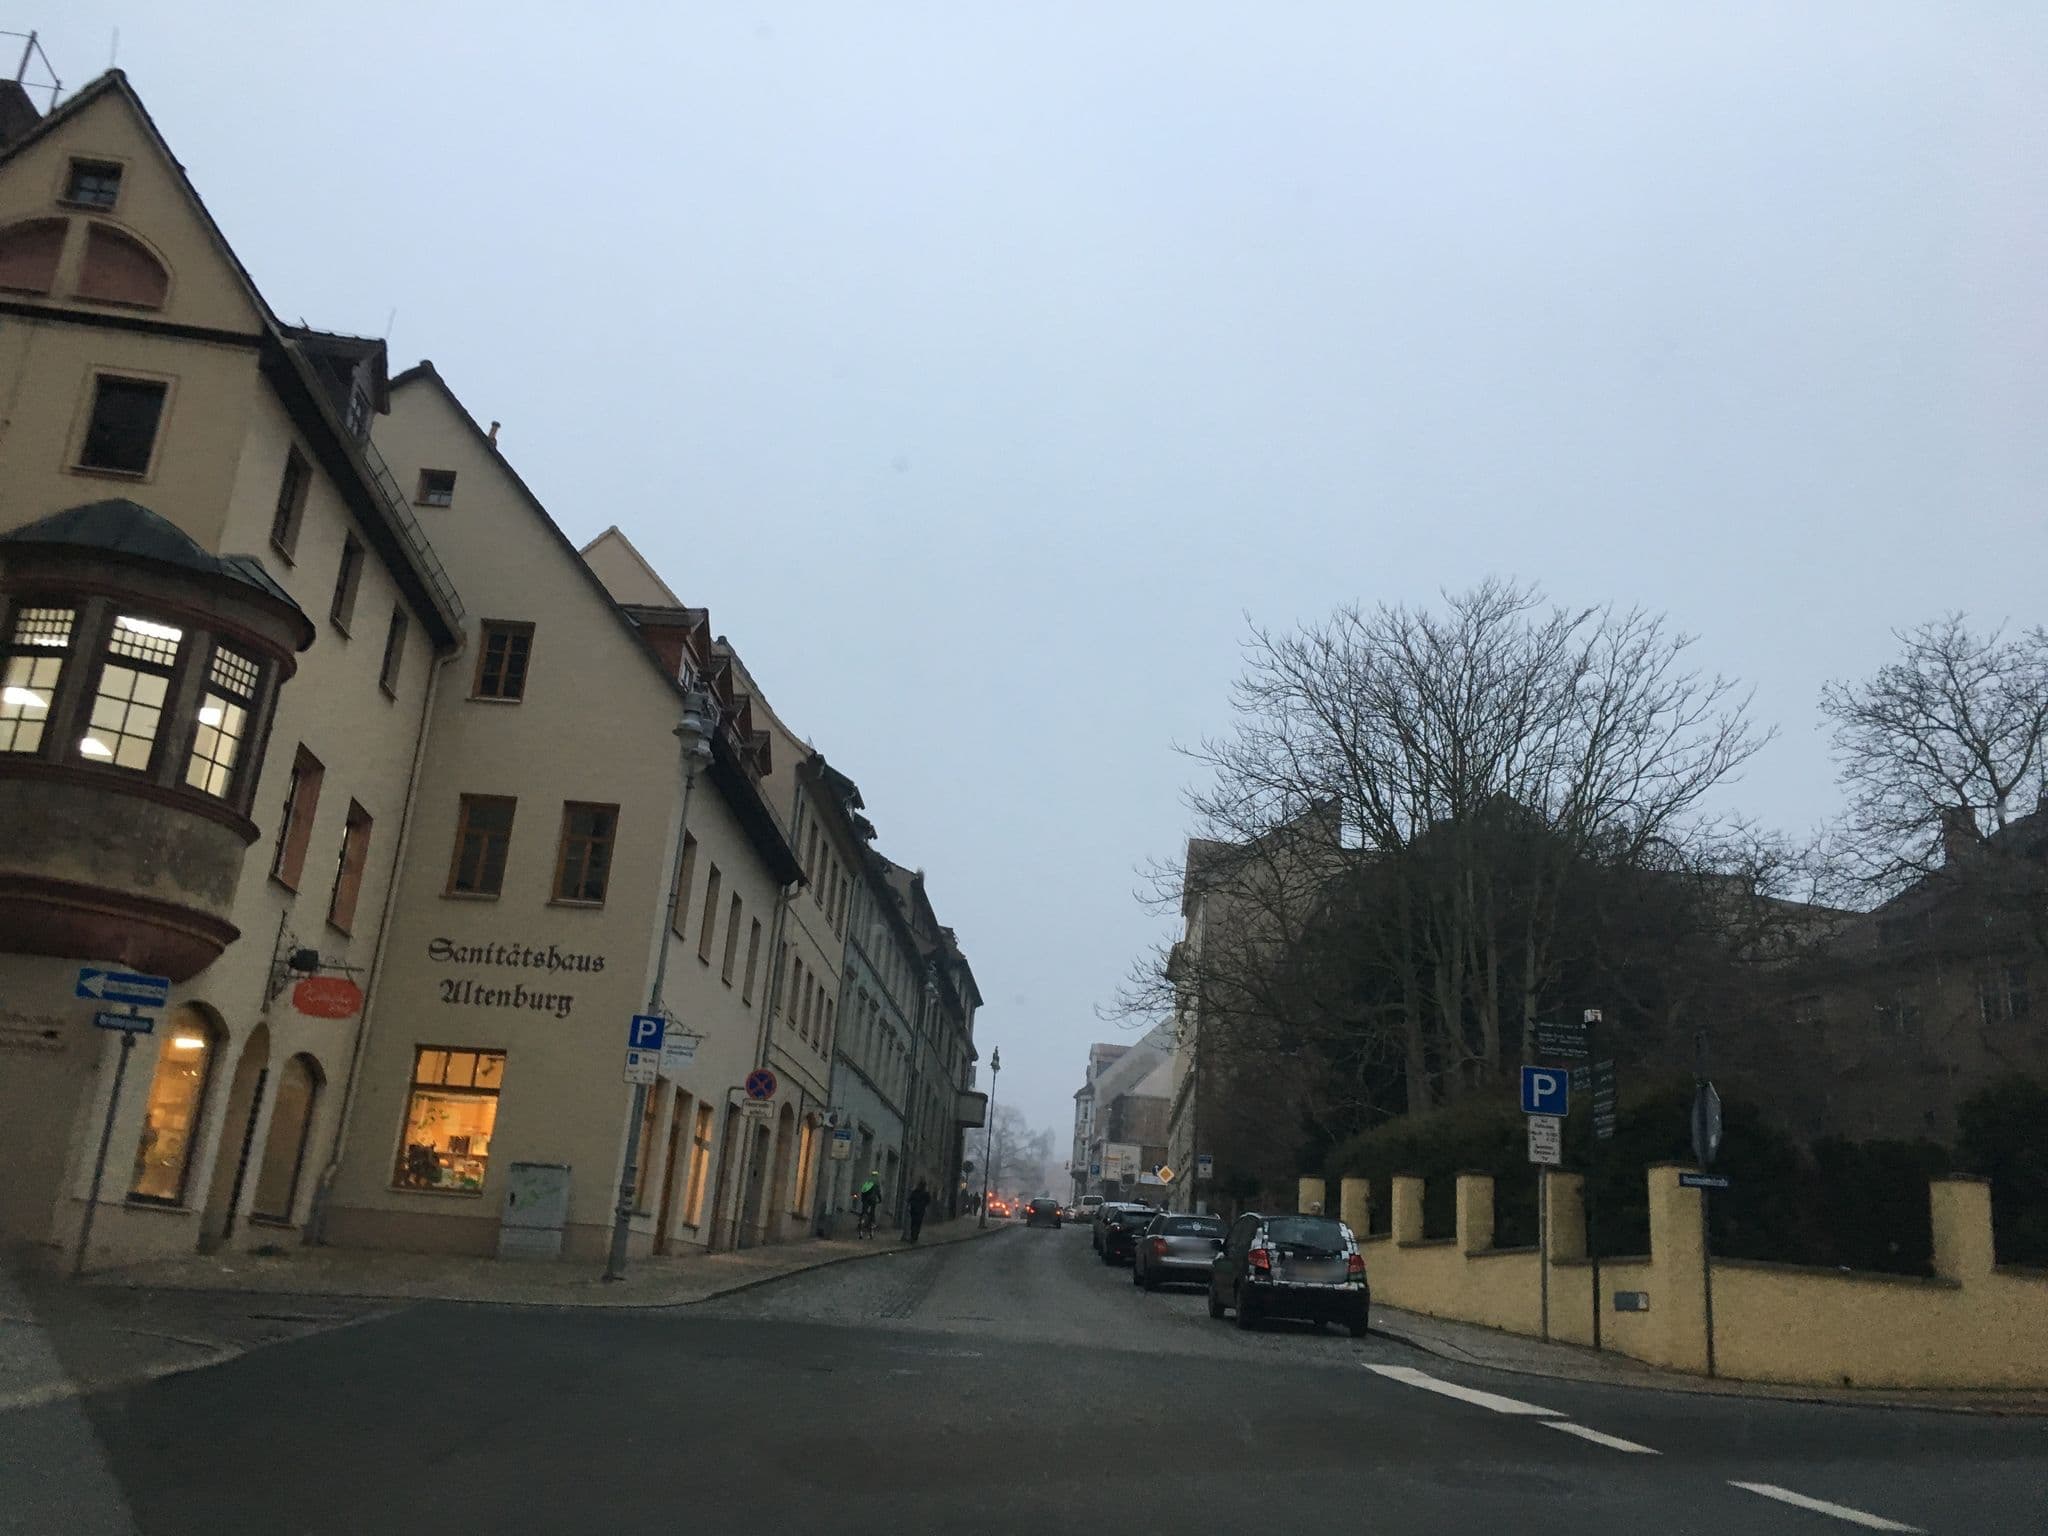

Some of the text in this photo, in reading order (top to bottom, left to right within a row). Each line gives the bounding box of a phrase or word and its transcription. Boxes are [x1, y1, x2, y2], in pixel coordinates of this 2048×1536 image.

[429, 937, 606, 974] Sanitätshaus
[440, 979, 575, 1018] Altenburg
[637, 1020, 657, 1044] P
[1533, 1074, 1557, 1107] P
